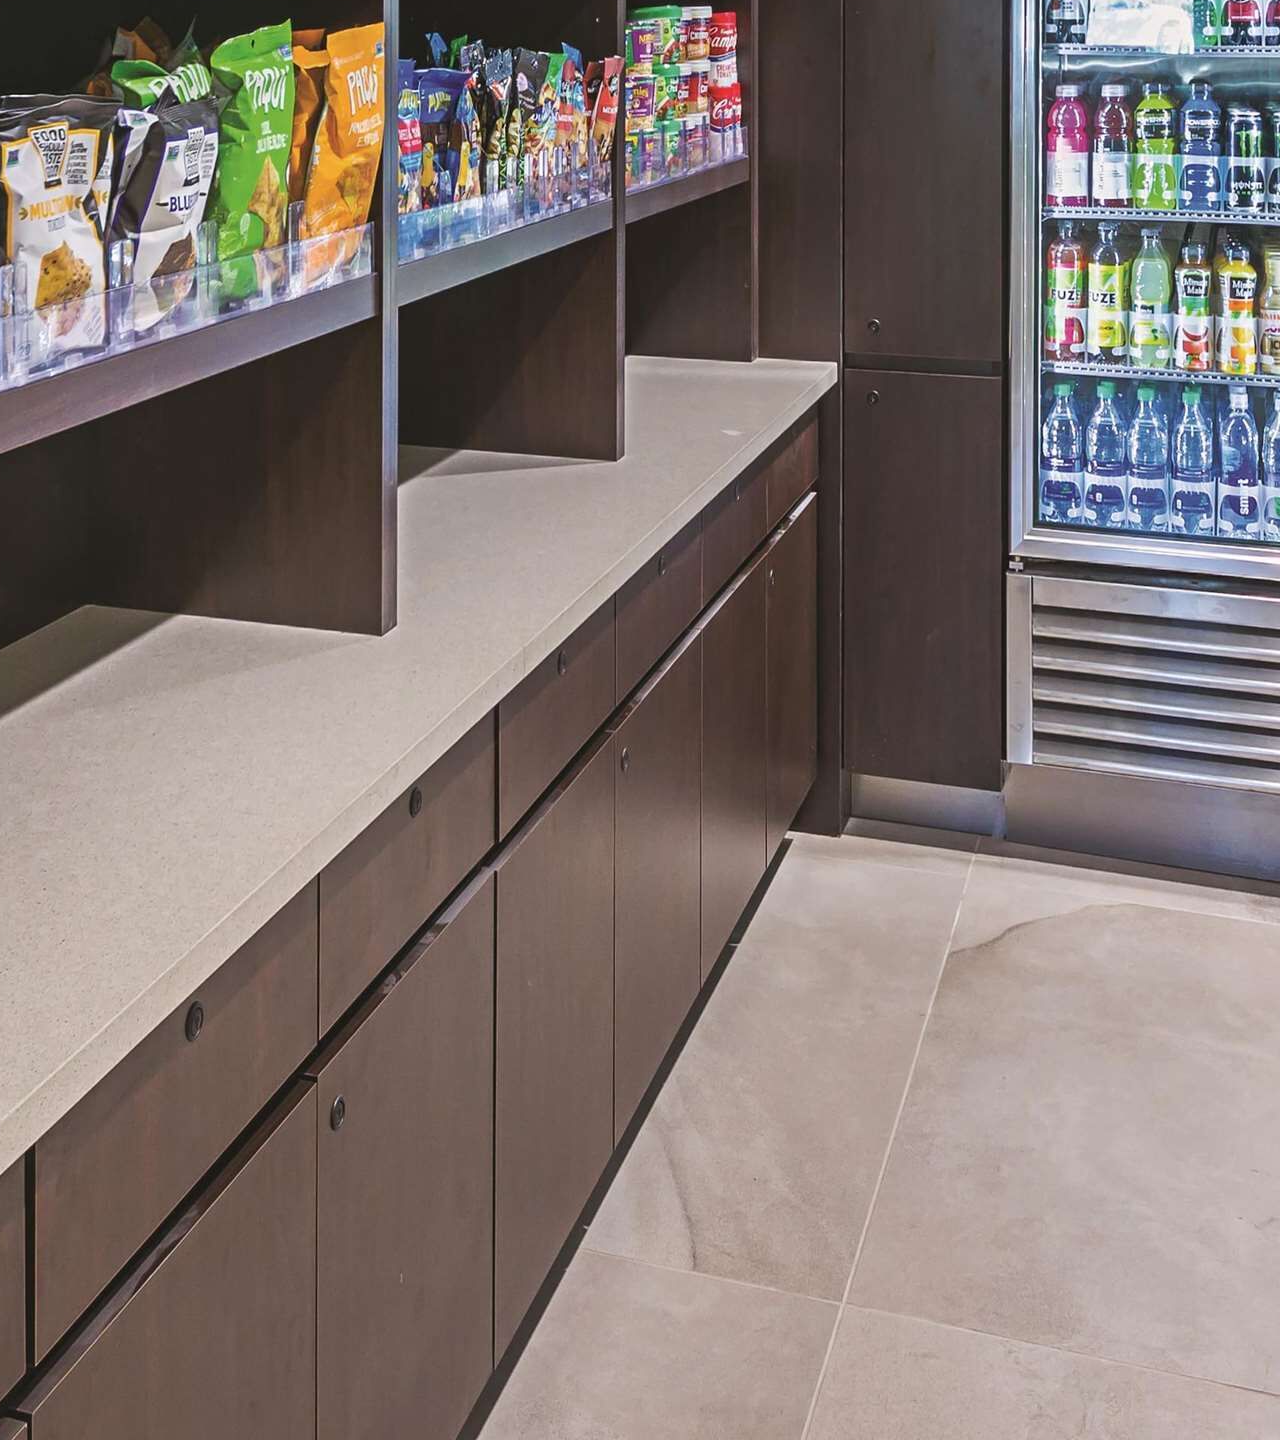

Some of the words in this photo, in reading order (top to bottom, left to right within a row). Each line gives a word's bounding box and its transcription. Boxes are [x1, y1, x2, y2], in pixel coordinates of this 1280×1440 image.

[150, 63, 211, 104] PAQUI
[245, 66, 290, 115] PAQUI
[347, 65, 378, 115] PAQUI
[33, 128, 66, 145] FOOD
[1089, 289, 1118, 305] FUZE
[1238, 478, 1250, 516] smart
